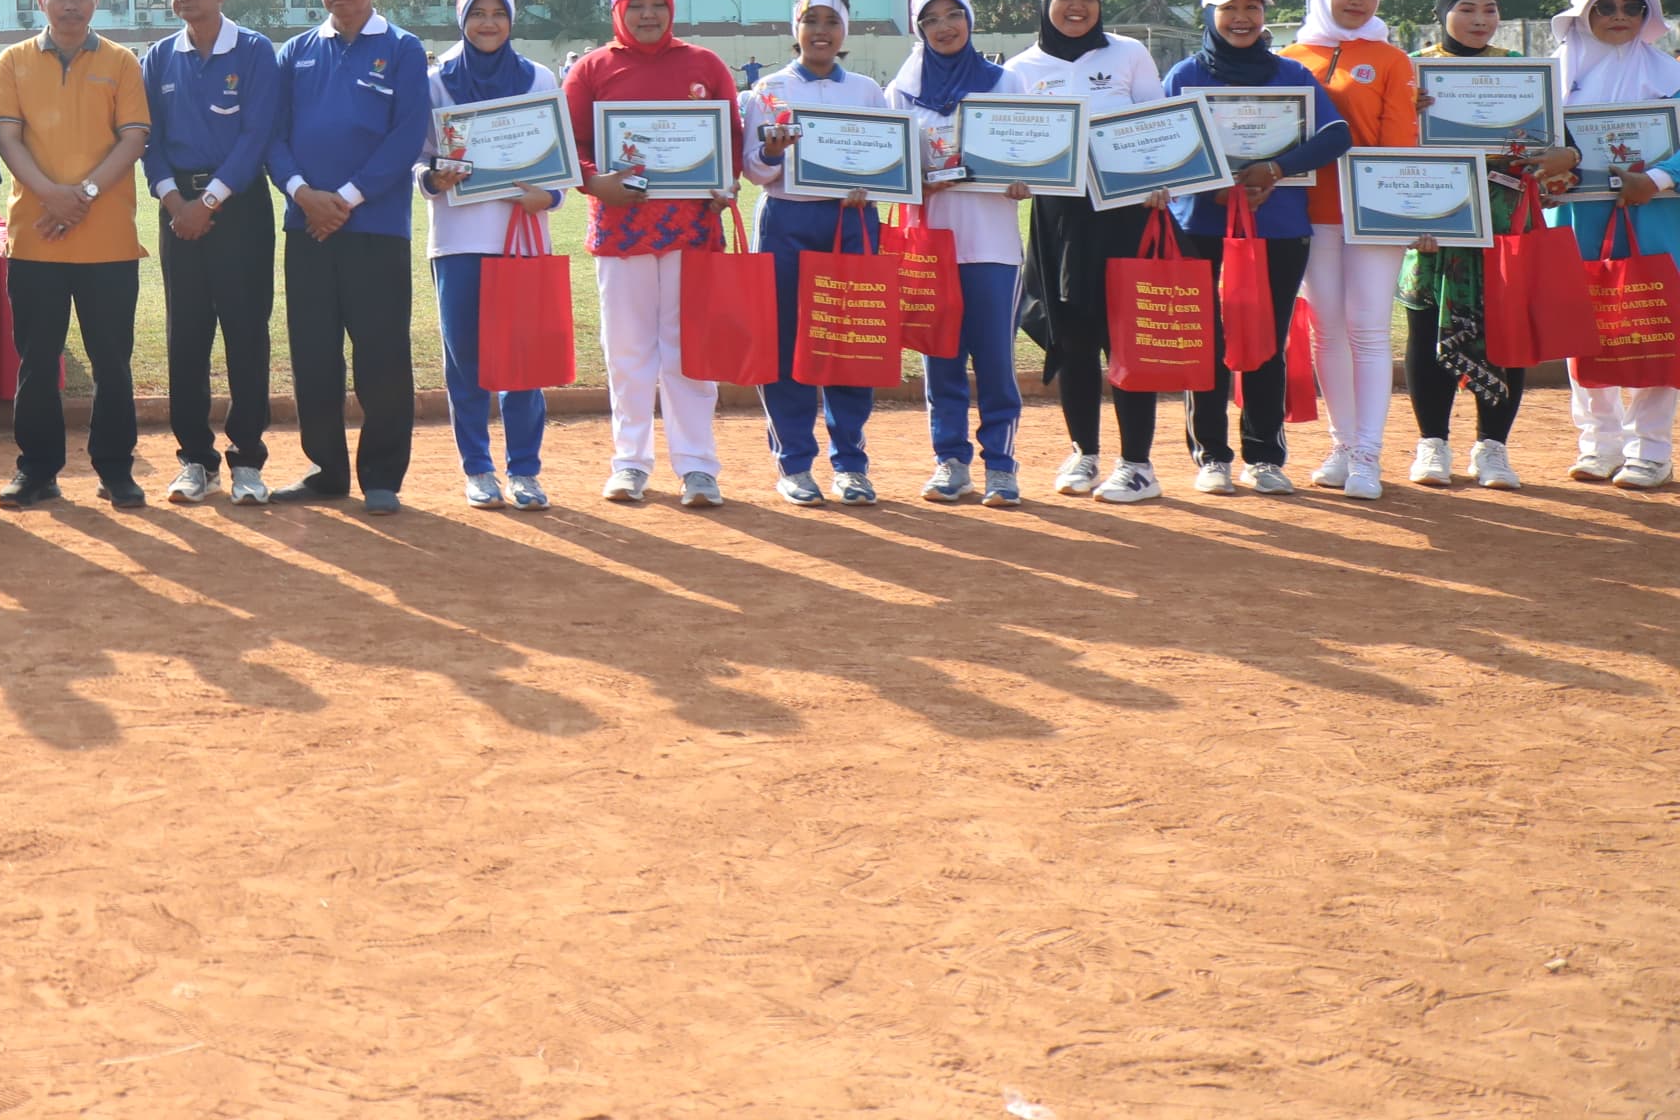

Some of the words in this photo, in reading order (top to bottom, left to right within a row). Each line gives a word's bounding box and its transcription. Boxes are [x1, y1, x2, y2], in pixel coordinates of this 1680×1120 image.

[1400, 168, 1422, 176] JUARA
[1413, 180, 1454, 190] Andayani
[1136, 284, 1173, 295] WAHYU
[1624, 281, 1664, 293] REDJO
[1136, 300, 1167, 312] WAHYU
[1621, 298, 1667, 310] GANESYA
[1136, 320, 1168, 330] WAHYU
[1631, 316, 1672, 327] TRISNA
[1152, 338, 1178, 348] GALUH
[1641, 332, 1675, 343] HARDJO
